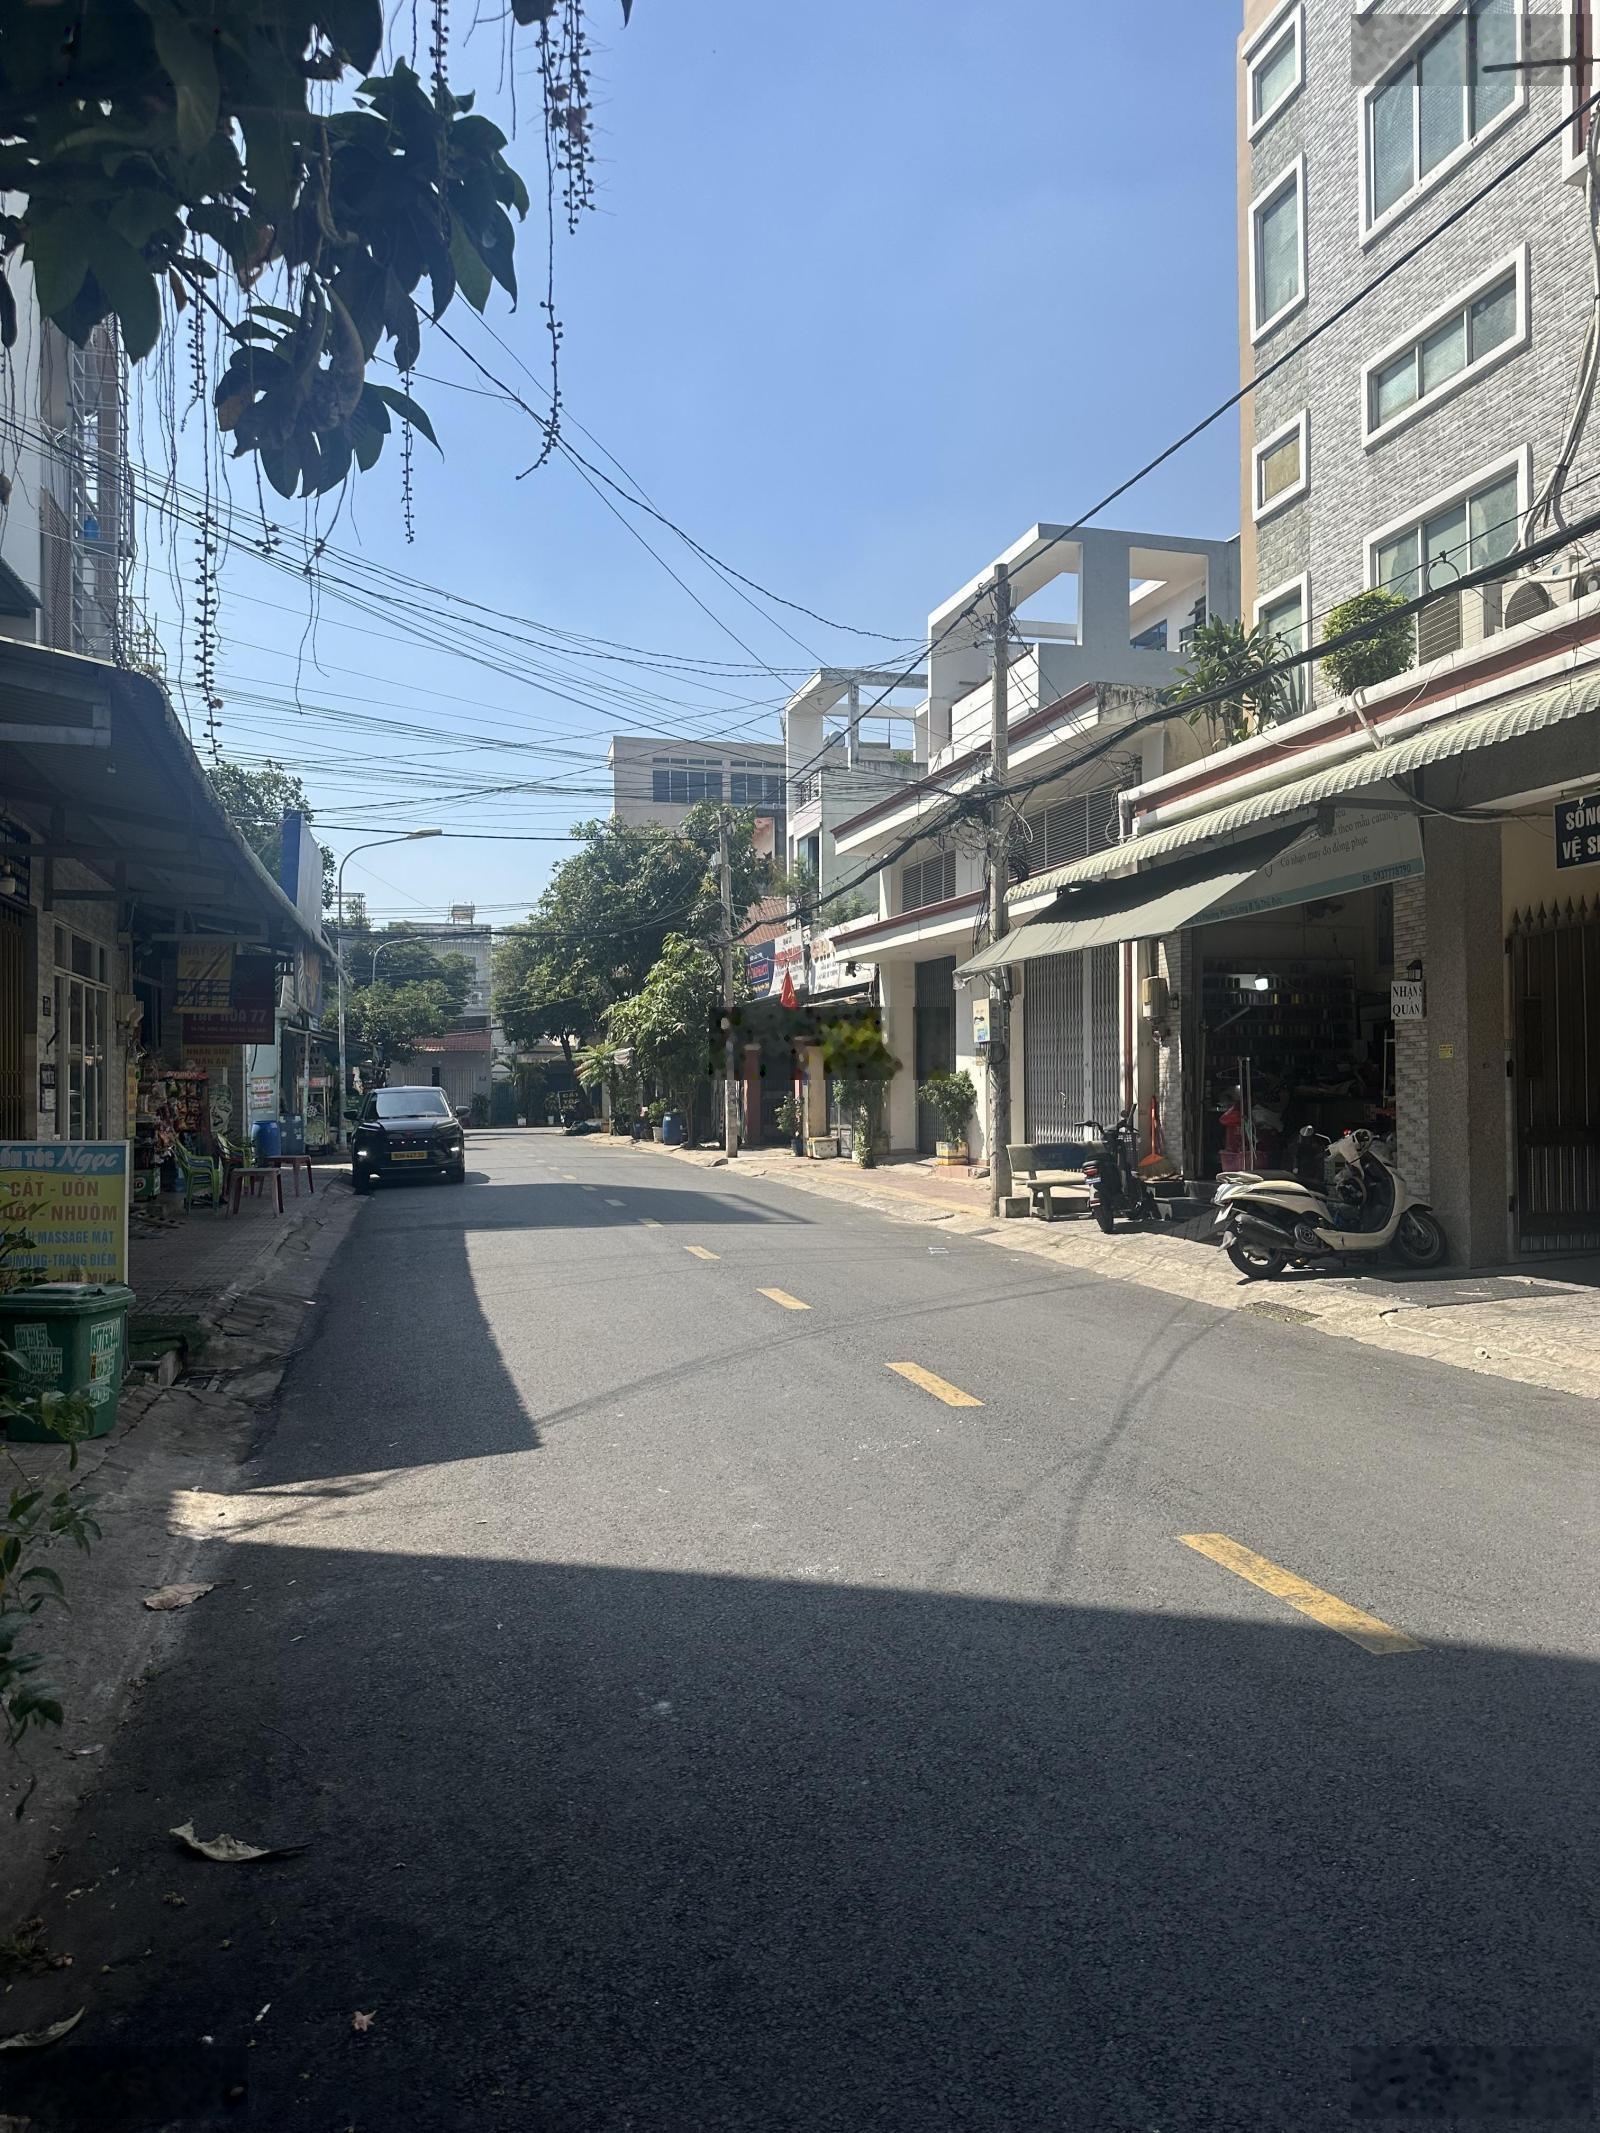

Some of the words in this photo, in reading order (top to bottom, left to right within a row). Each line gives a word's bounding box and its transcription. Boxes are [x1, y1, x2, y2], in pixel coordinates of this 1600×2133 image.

[1562, 836, 1582, 862] VỆ
[56, 1146, 119, 1173] Ngọc
[10, 1176, 45, 1198] CẮT
[61, 1176, 99, 1198] UỐN
[50, 1202, 118, 1225] NHUỘM
